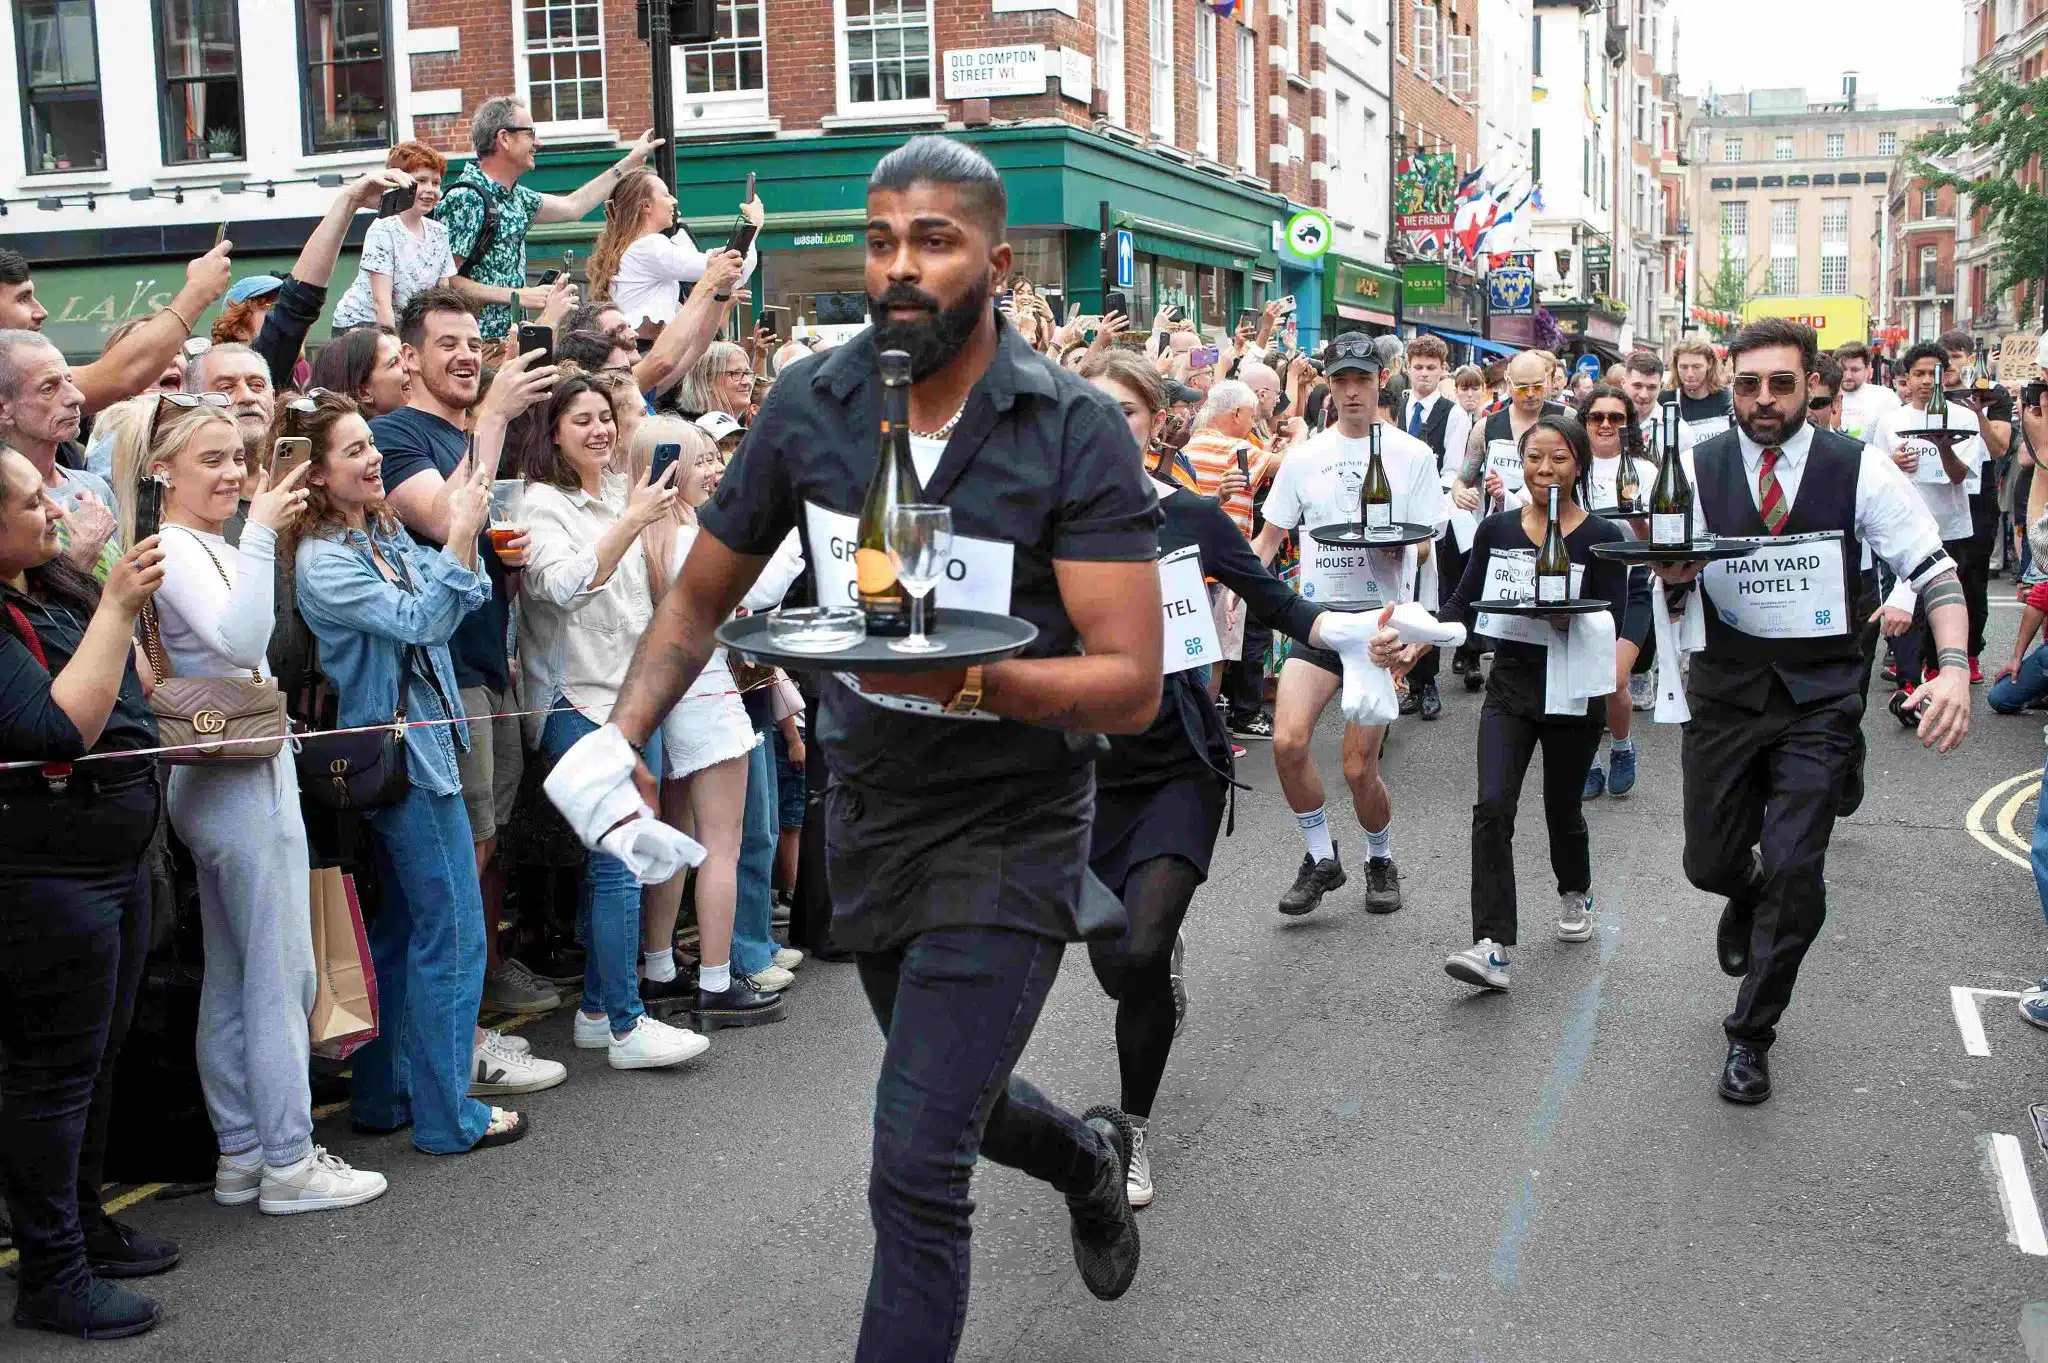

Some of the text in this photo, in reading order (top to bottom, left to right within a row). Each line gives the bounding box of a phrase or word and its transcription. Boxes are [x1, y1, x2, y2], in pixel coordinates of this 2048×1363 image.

[951, 50, 1036, 67] OLD COMPTON
[952, 68, 994, 82] STREET
[1403, 214, 1450, 226] THE FRENCH
[794, 233, 854, 246] wasabi.uk.com
[1407, 280, 1442, 288] ROSA'S
[1315, 556, 1365, 569] HOUSE 2
[1725, 555, 1820, 574] HAM YARD
[1738, 577, 1810, 595] HOTEL 1
